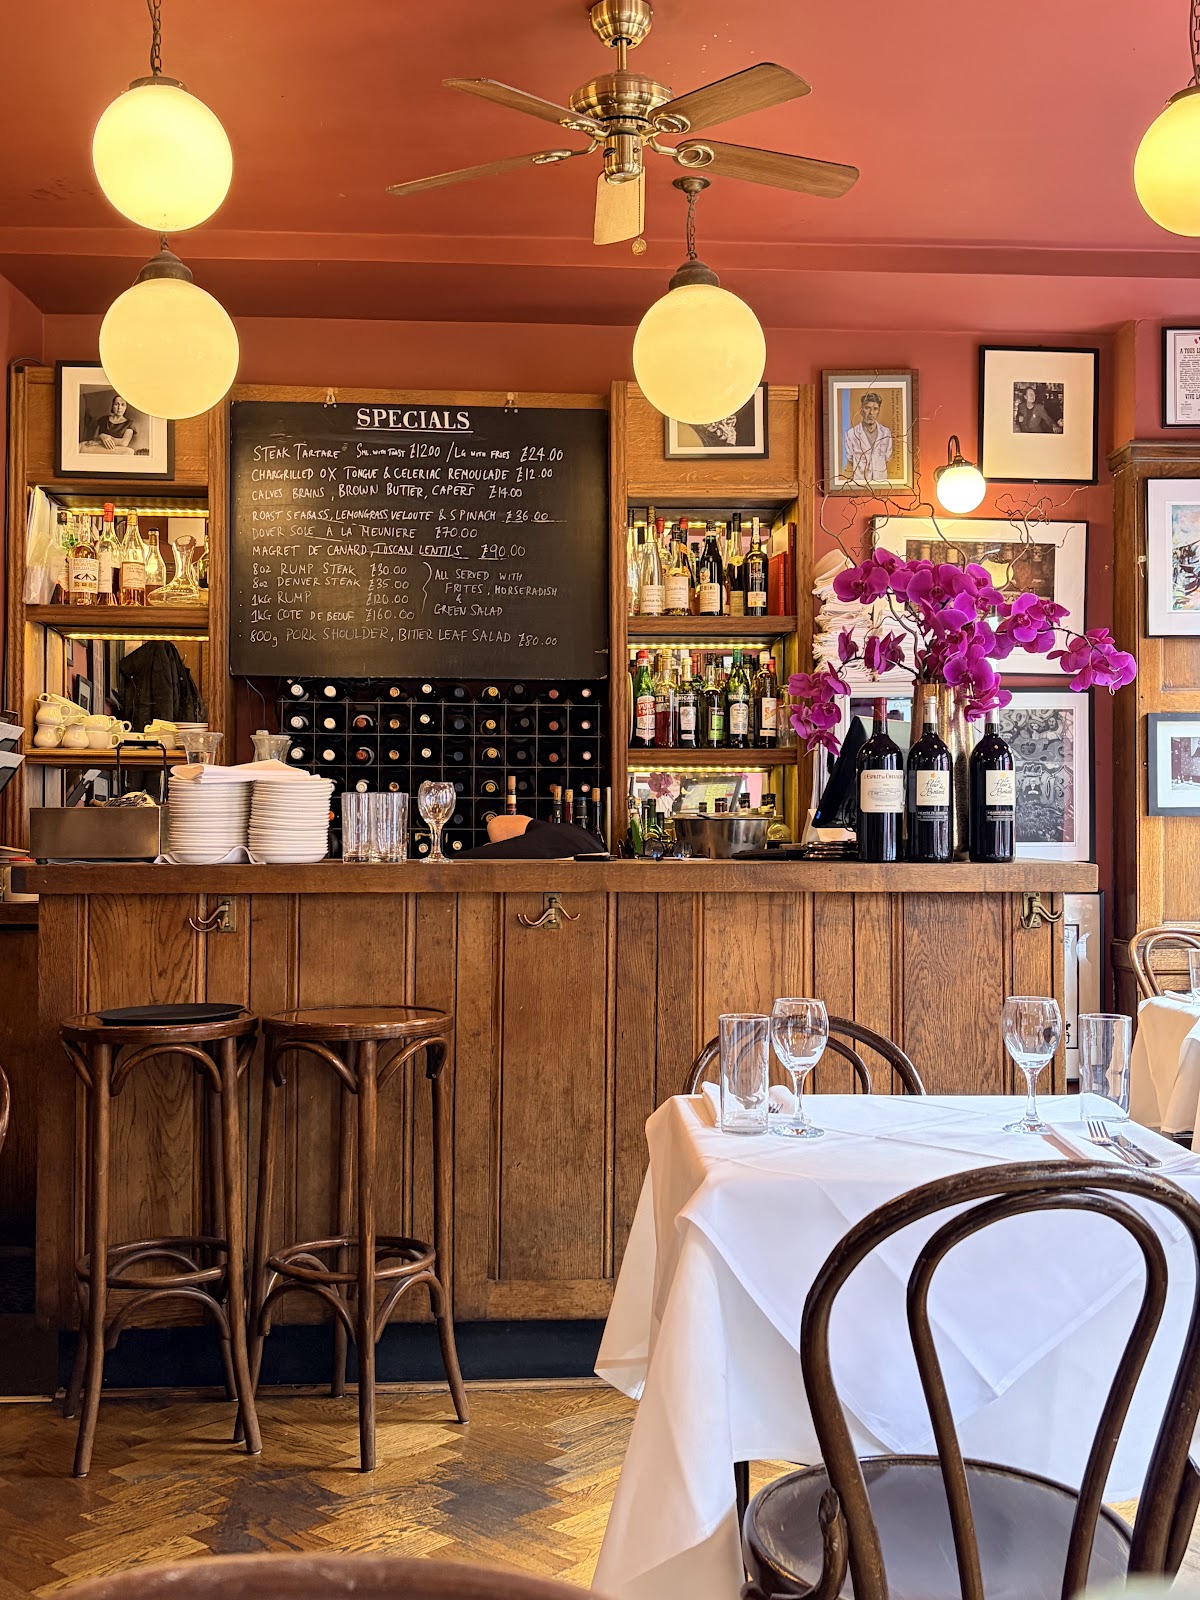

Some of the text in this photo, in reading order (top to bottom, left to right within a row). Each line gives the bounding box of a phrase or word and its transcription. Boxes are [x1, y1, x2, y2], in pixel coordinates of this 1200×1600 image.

[356, 408, 470, 429] SPECIALS
[253, 445, 290, 462] STEAK
[293, 443, 340, 460] TARTARE
[490, 450, 510, 460] FRIES
[520, 446, 564, 463] £24.00
[251, 466, 553, 482] CHARGRILLED OX TONGUE & CELERIAC REMOULADE £12.00
[252, 488, 283, 500] CALVES
[338, 484, 379, 498] BROWN
[386, 483, 428, 500] BUTTER,
[431, 485, 476, 496] CAPERS
[488, 485, 523, 499] £14.00
[252, 510, 283, 521] ROAST
[335, 509, 388, 520] LEMONGRASS
[391, 510, 433, 521] VELOUTE
[438, 508, 446, 521] &
[450, 509, 496, 521] SPINACH
[252, 527, 284, 540] DOVER
[290, 525, 316, 537] SOLE
[341, 527, 352, 536] LA
[361, 527, 417, 538] MEUNIERE
[435, 526, 478, 539] £70.00
[252, 545, 300, 556] MAGRET
[308, 545, 322, 556] DE
[419, 545, 463, 556] LENTILS
[481, 544, 526, 559] £90.00
[280, 563, 314, 575] RUMP
[323, 562, 356, 577] STEAK
[370, 563, 407, 577] £30.00
[435, 568, 523, 582] ALL SERVED WITH
[277, 576, 321, 587] DENVER
[325, 577, 360, 587] STEAK
[368, 578, 409, 591] £35.00
[494, 585, 558, 597] HORSERADISH
[277, 590, 312, 604] RUMP
[365, 592, 409, 606] £120.00
[456, 593, 463, 604] &
[277, 609, 303, 621] COTE
[310, 611, 323, 621] DE
[365, 608, 415, 622] £160.00
[434, 604, 503, 616] GREEN SALAD
[250, 626, 558, 648] 800g PORK SHOULDER, BITTER LEAF SALAD £80.00
